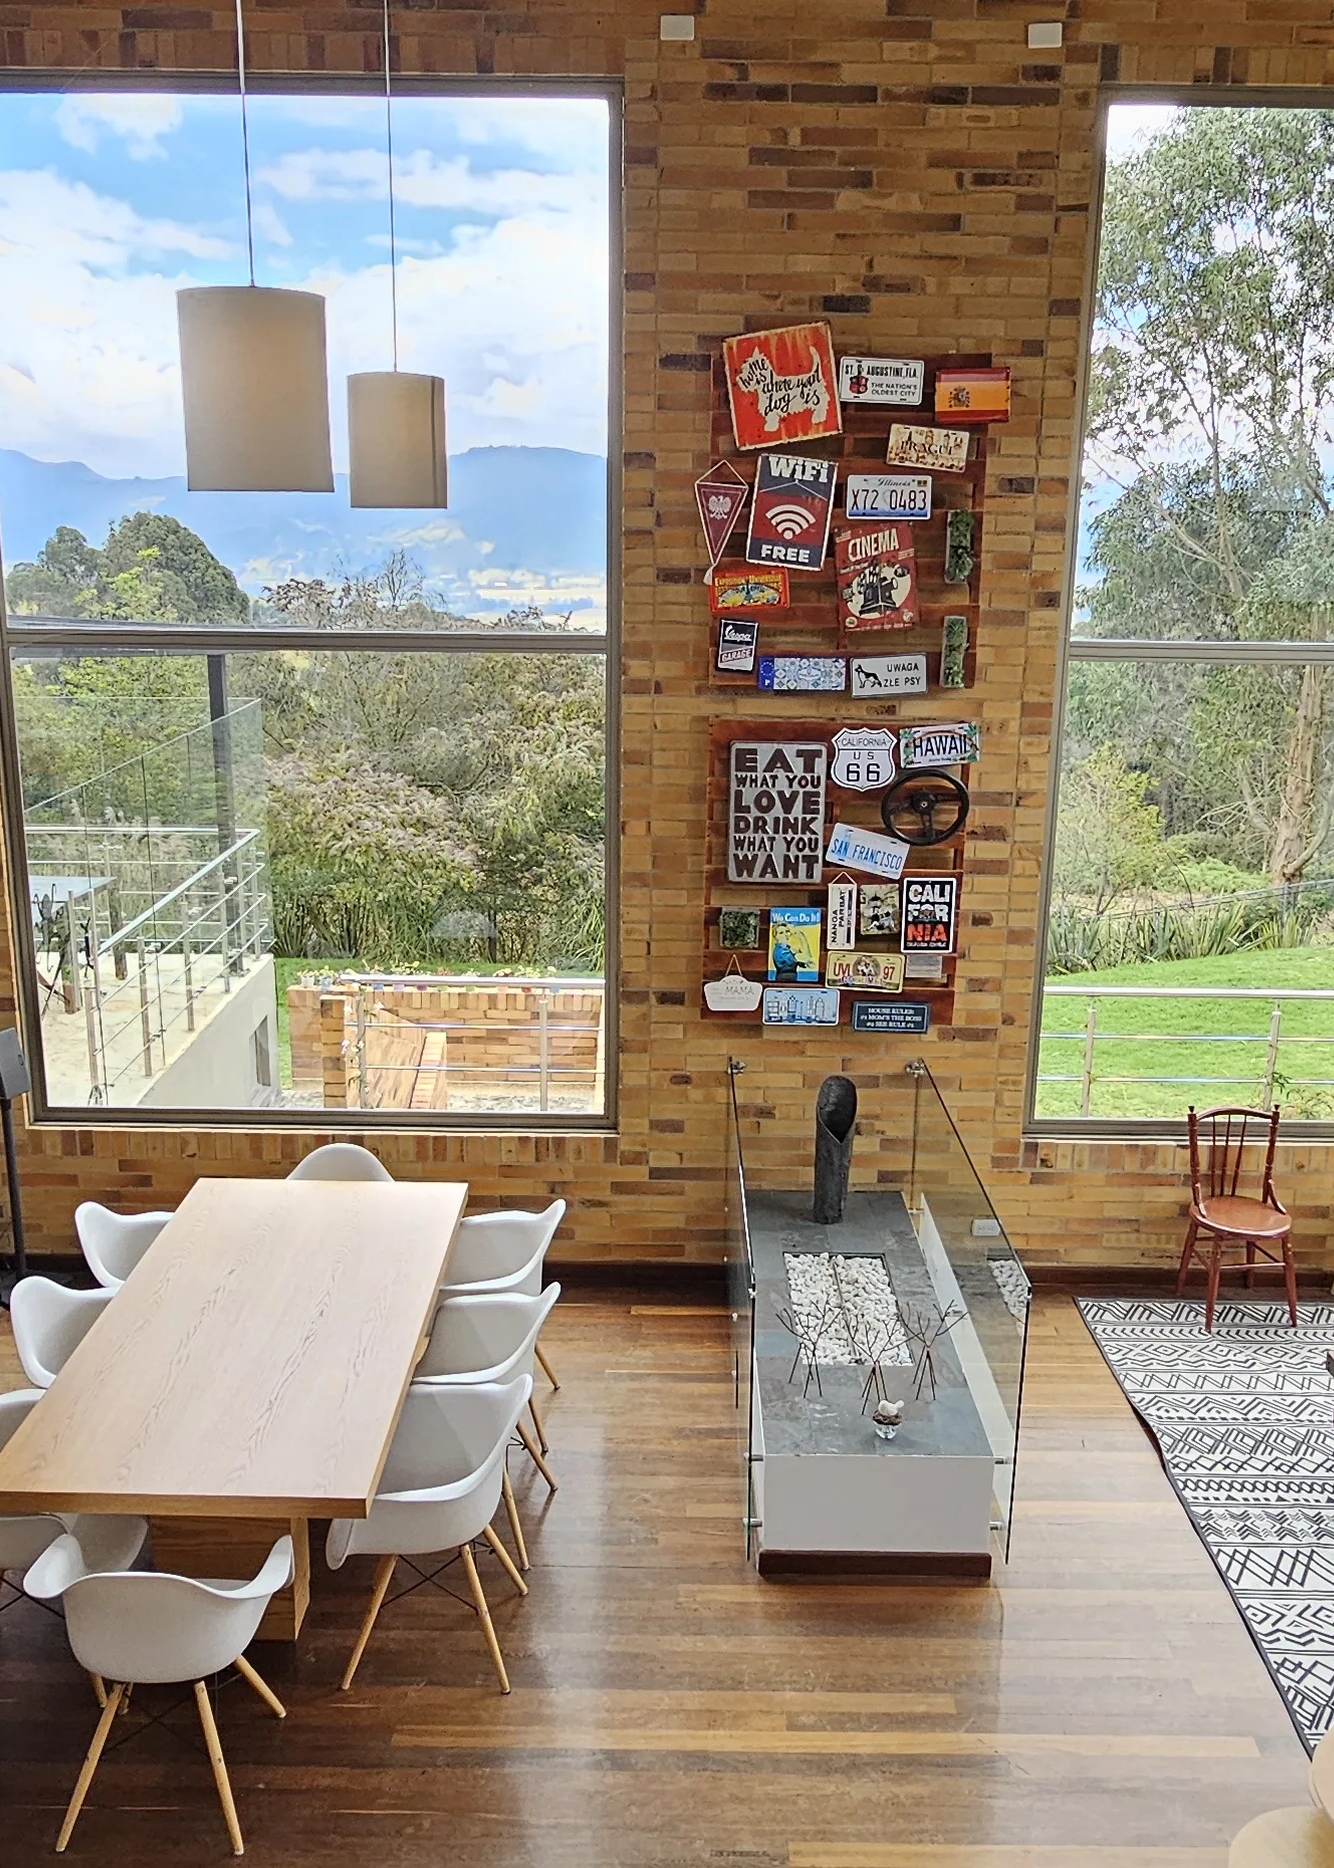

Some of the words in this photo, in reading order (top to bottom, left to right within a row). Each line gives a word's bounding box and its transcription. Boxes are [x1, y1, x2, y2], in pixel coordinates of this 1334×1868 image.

[739, 359, 768, 388] home
[756, 373, 767, 385] is
[762, 369, 795, 394] where
[764, 393, 797, 416] dog
[803, 389, 820, 406] is
[768, 456, 828, 483] WiFi
[876, 478, 911, 487] Illinois
[851, 489, 879, 511] X72
[889, 489, 927, 511] 0483
[760, 544, 810, 563] FREE
[848, 528, 900, 562] CINEMA
[724, 625, 752, 642] Vespa
[721, 649, 751, 662] GARAGE
[887, 663, 920, 673] UWAGA
[904, 676, 921, 686] PSY
[841, 737, 887, 746] CALIFORNIA
[913, 734, 967, 757] HAWAII
[735, 748, 823, 774] EAT
[734, 774, 778, 788] WHAT
[785, 775, 822, 789] YOU
[846, 763, 880, 782] 66
[734, 789, 821, 815] LOVE
[733, 815, 819, 835] DRINK
[733, 836, 776, 852] WHAT
[783, 837, 819, 853] YOU
[831, 838, 851, 857] SAN
[852, 844, 903, 870] FRANCISCO
[733, 853, 820, 879] WANT
[908, 884, 951, 903] CALI
[784, 912, 799, 922] Can
[799, 912, 810, 922] Do
[907, 904, 949, 922] FOR
[907, 924, 947, 941] NIA
[883, 966, 896, 980] 97
[725, 986, 755, 996] MAMA
